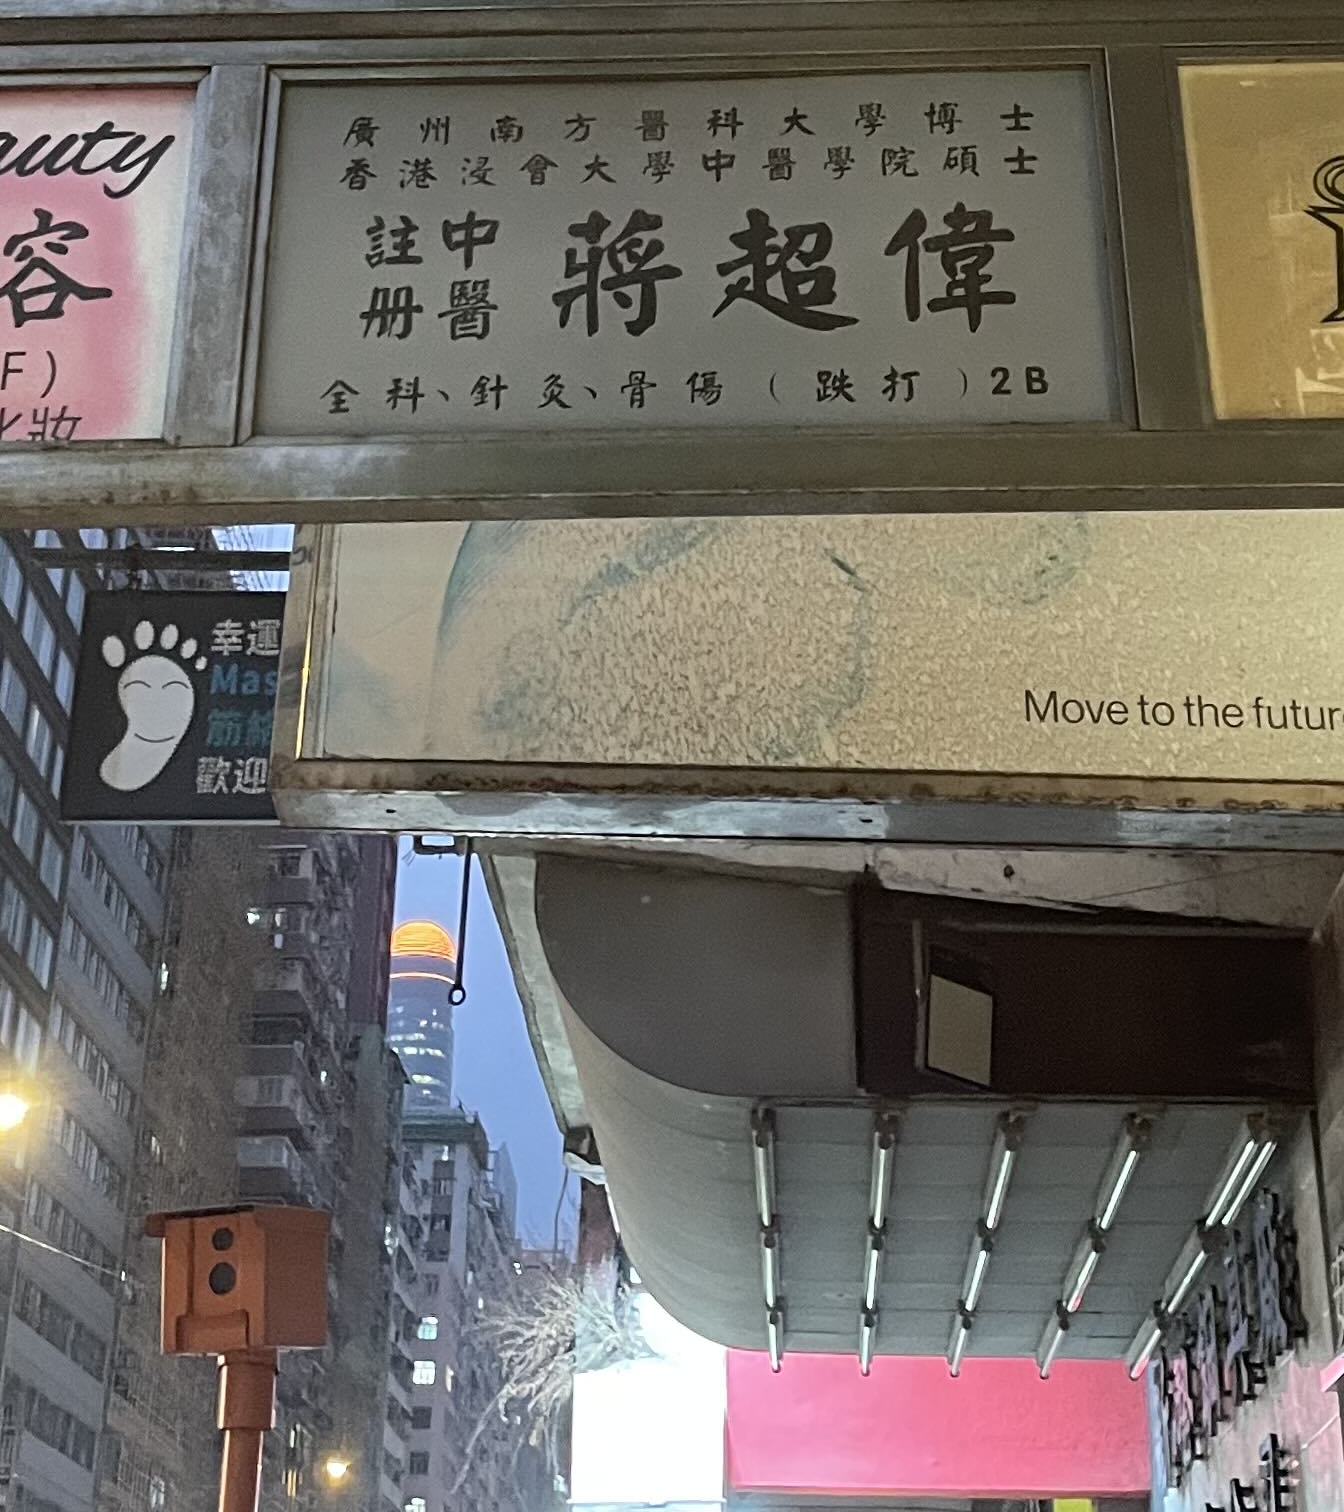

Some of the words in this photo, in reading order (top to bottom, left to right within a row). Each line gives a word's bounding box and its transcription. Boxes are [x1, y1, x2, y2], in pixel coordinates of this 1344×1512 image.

[341, 102, 1036, 148] 廣州南方醫科大學博士
[339, 145, 1040, 191] 香港浸會大學中醫學院碩士
[551, 201, 1017, 338] 蔣超偉
[211, 619, 280, 656] 幸運
[1024, 690, 1129, 725] Move
[1137, 695, 1174, 726] to
[1184, 696, 1245, 728] the
[197, 755, 268, 794] 歡迎
